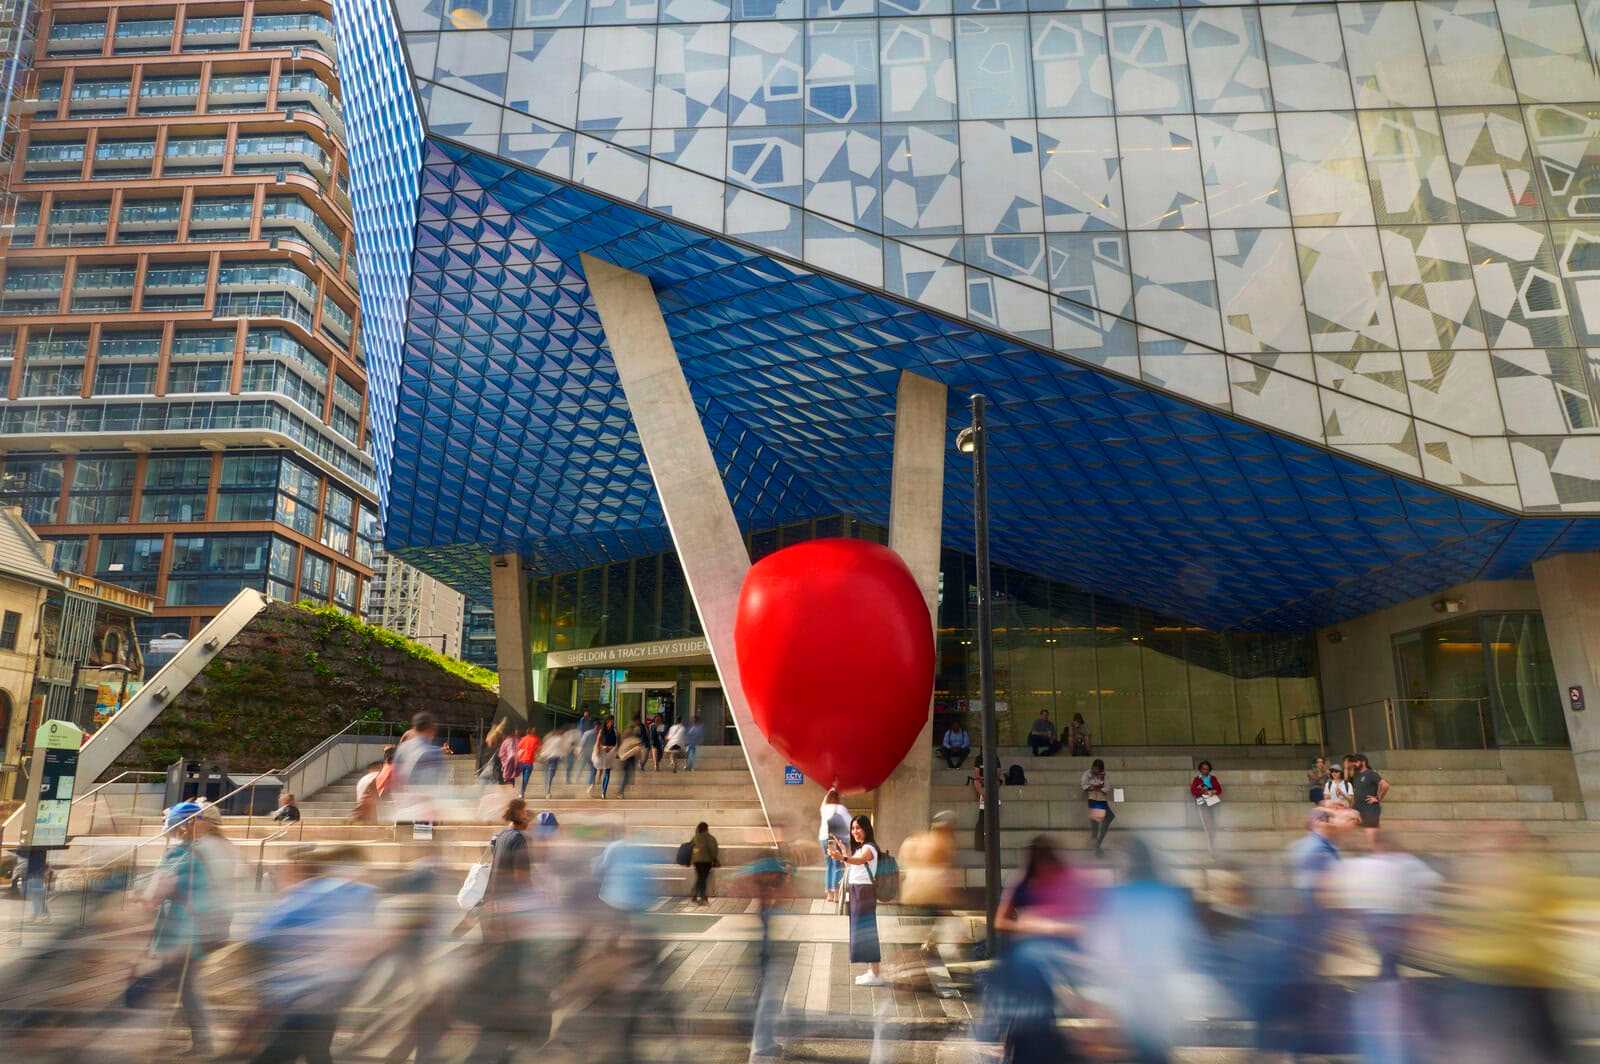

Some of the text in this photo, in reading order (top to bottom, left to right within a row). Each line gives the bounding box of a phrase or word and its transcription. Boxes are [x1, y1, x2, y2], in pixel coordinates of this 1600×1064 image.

[567, 649, 607, 663] SHELDON
[608, 650, 616, 660] &
[618, 646, 645, 658] TRACY
[647, 644, 671, 656] LEVY
